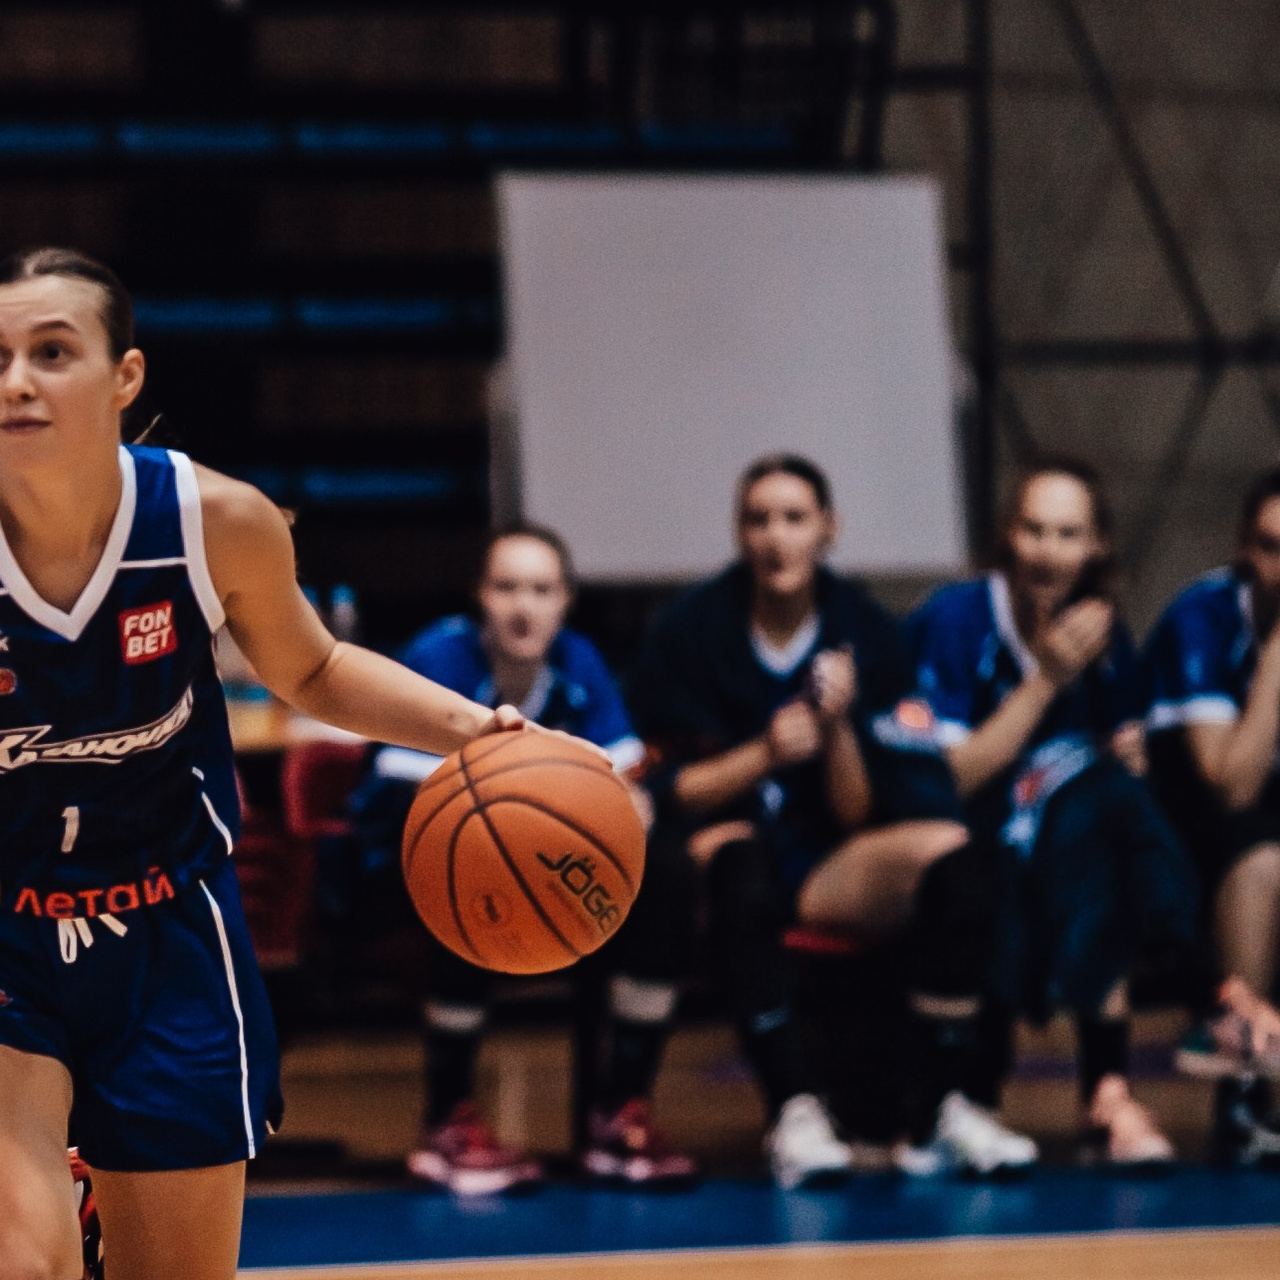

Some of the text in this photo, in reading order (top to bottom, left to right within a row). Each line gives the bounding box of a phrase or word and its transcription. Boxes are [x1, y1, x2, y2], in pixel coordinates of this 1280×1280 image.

[124, 606, 172, 637] FON
[126, 625, 172, 659] BET
[60, 806, 80, 854] 1
